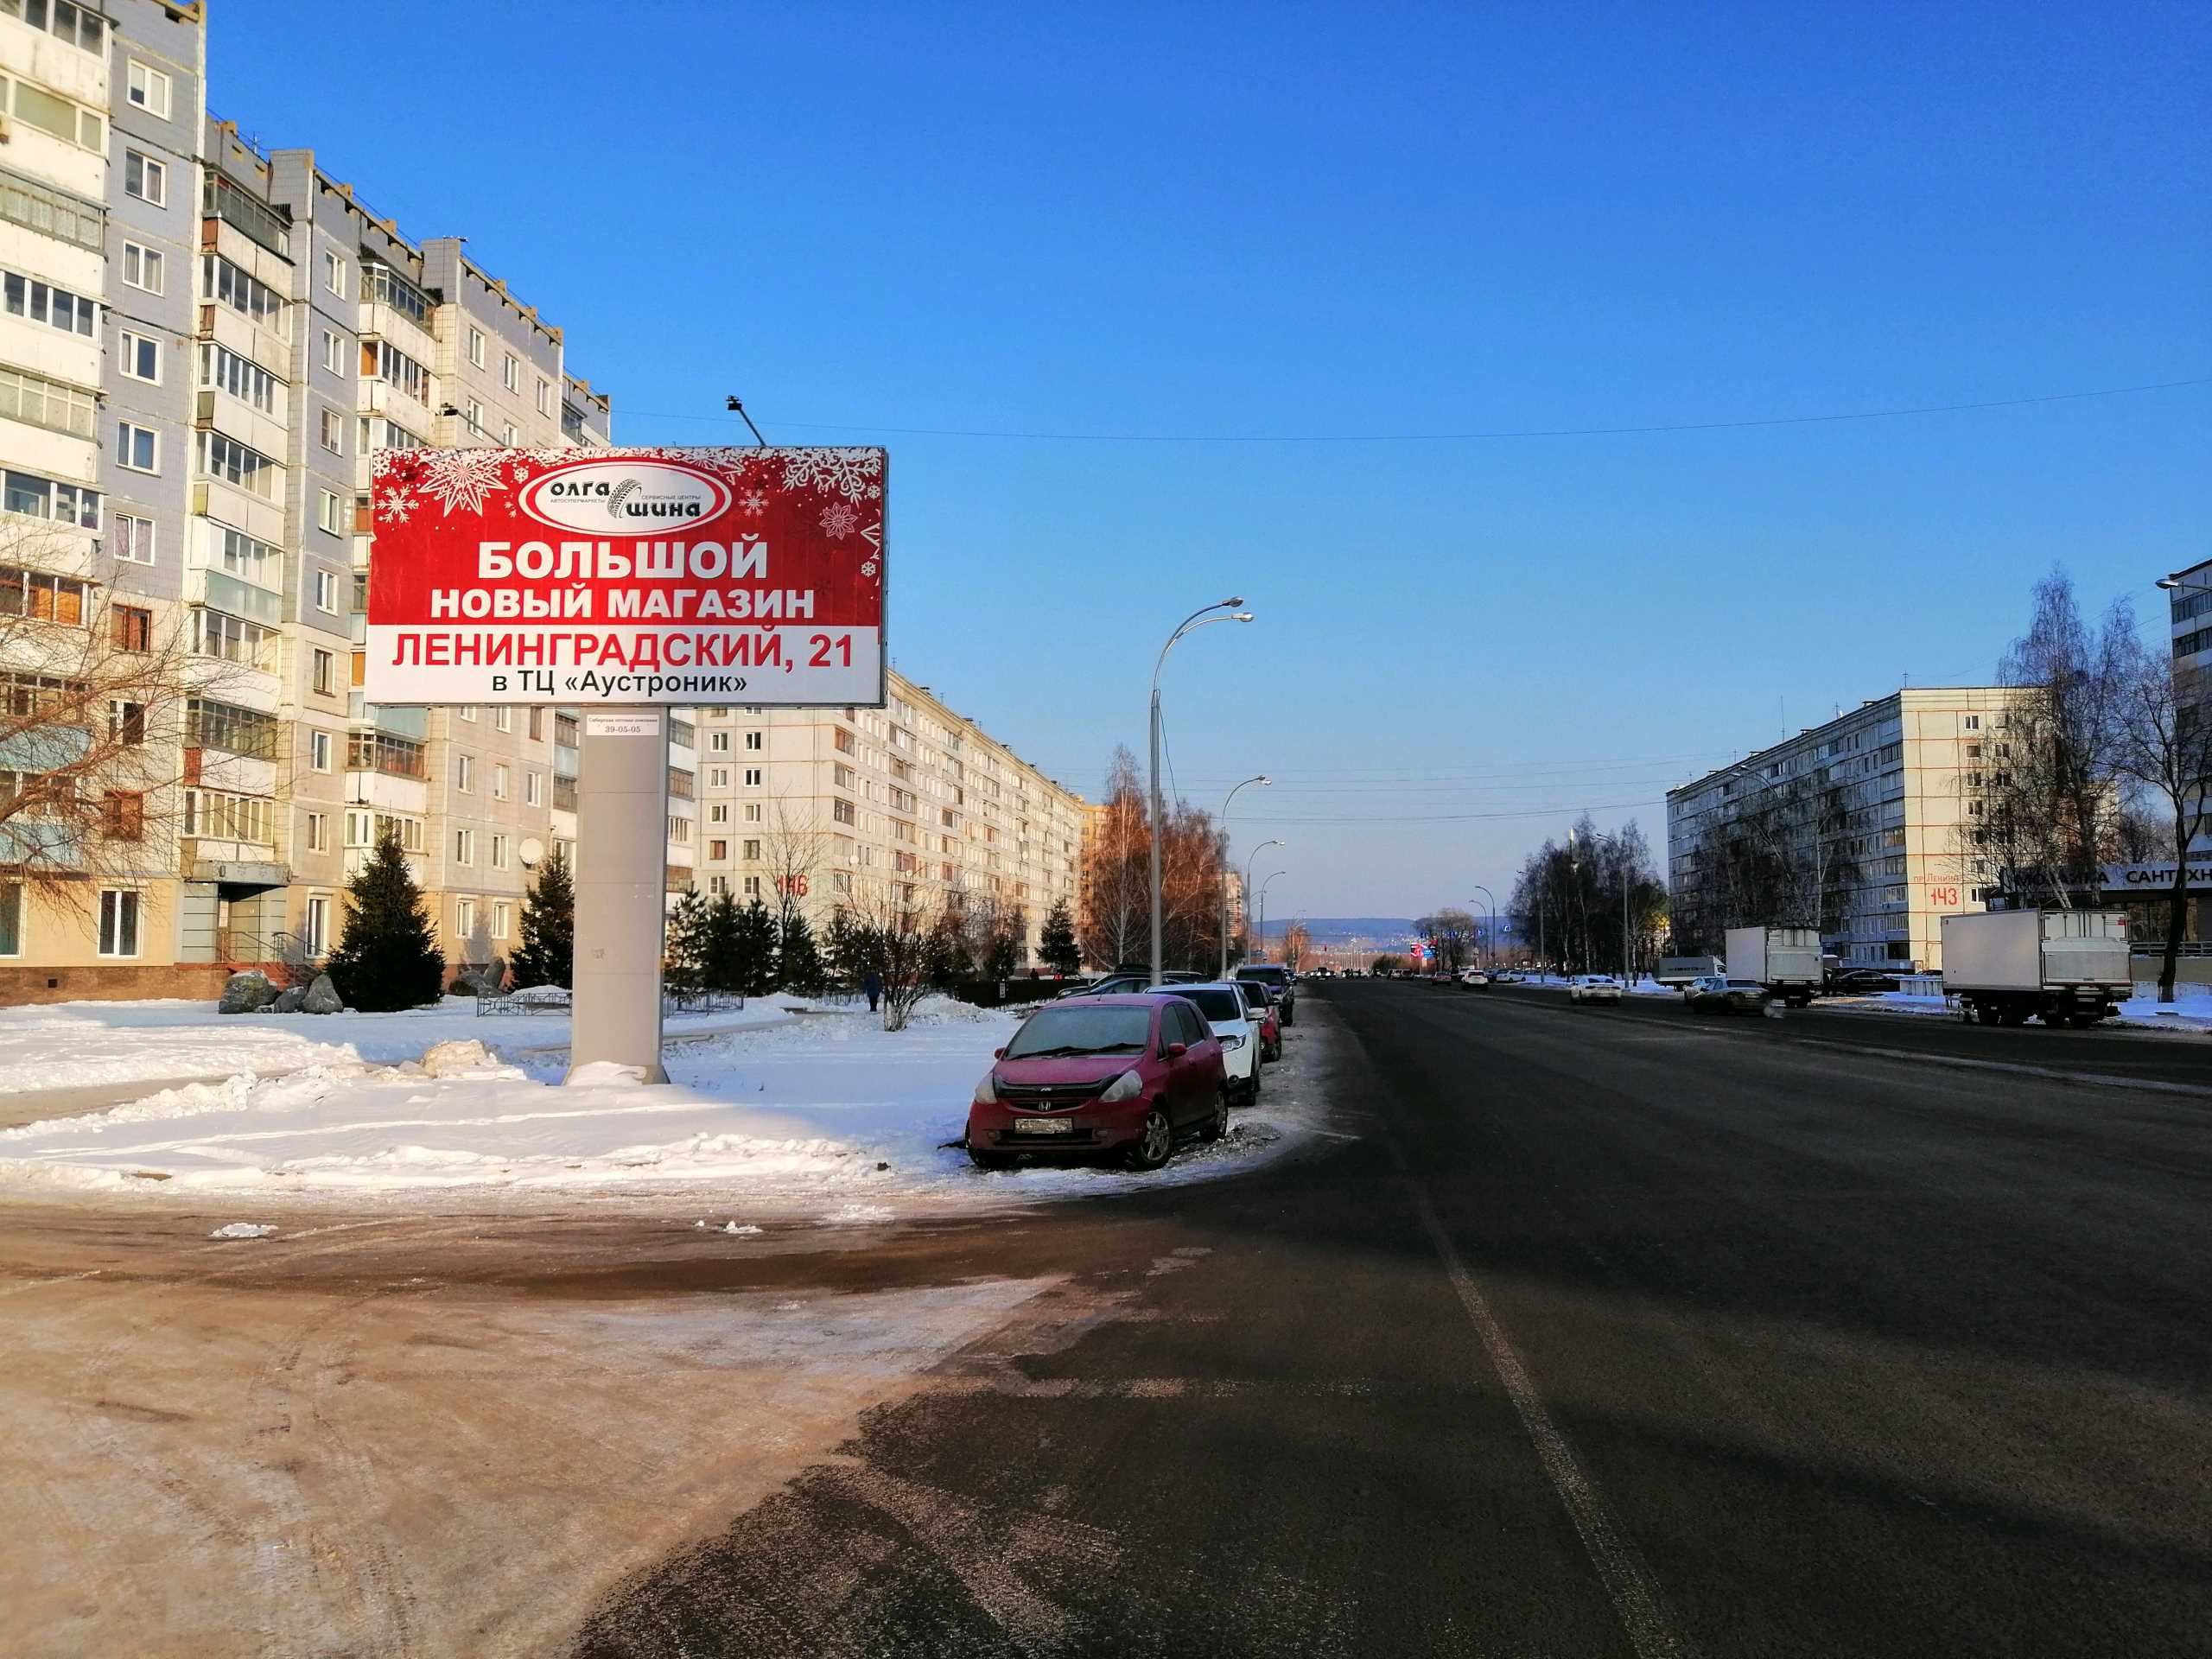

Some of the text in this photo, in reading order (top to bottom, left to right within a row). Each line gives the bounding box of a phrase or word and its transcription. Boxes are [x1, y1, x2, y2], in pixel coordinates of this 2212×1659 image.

[478, 533, 767, 579] БОЛЬШОЙ
[430, 582, 815, 619] НОВЫЙ МАГАЗИН
[392, 625, 852, 673] ЛЕНИНГРАДСКИЙ, 21
[493, 670, 747, 697] в ТЦ «Аустроник»
[2126, 868, 2212, 883] САНТХН
[1930, 887, 1957, 906] 143
